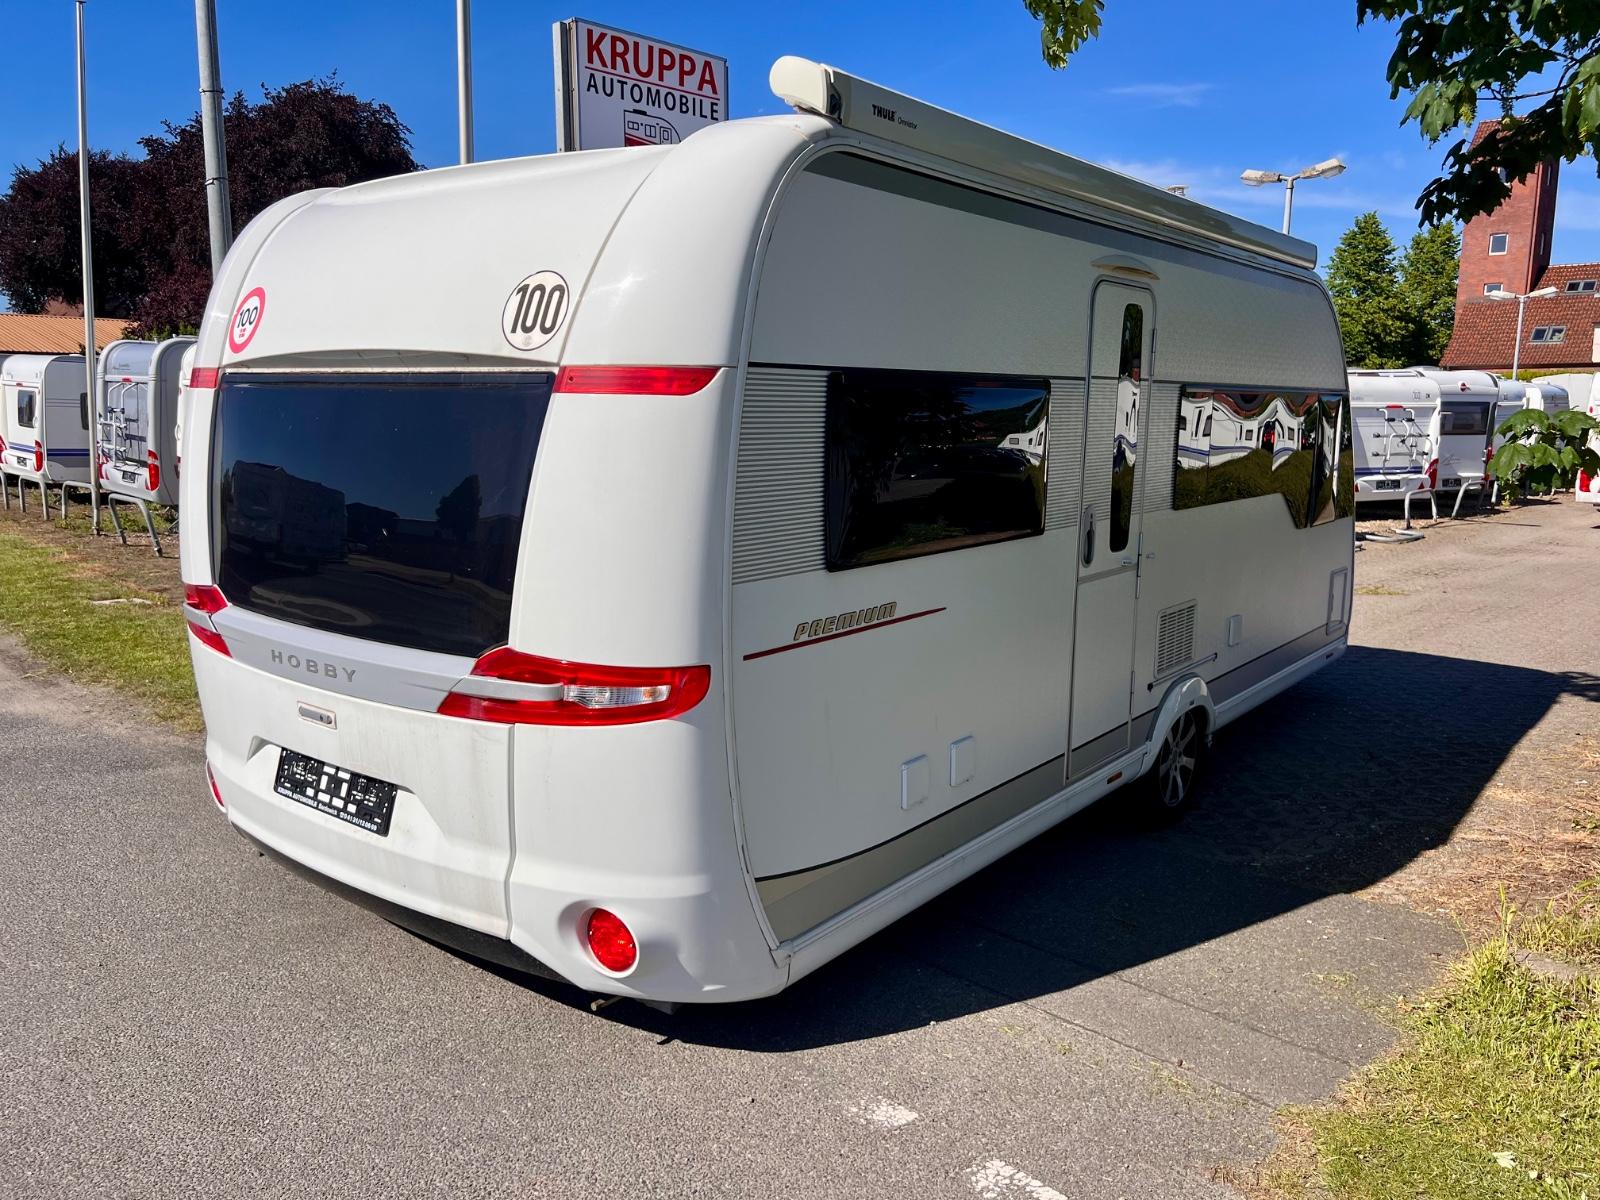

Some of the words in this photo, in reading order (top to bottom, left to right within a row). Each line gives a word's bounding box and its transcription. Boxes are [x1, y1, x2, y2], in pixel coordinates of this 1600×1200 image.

[586, 28, 718, 95] KRUPPA
[586, 72, 719, 121] AUTOMOBILE
[872, 104, 896, 122] THULE
[237, 306, 258, 328] 100
[510, 283, 566, 335] 100
[793, 601, 897, 641] PREMIUM
[271, 649, 356, 683] HOBBY
